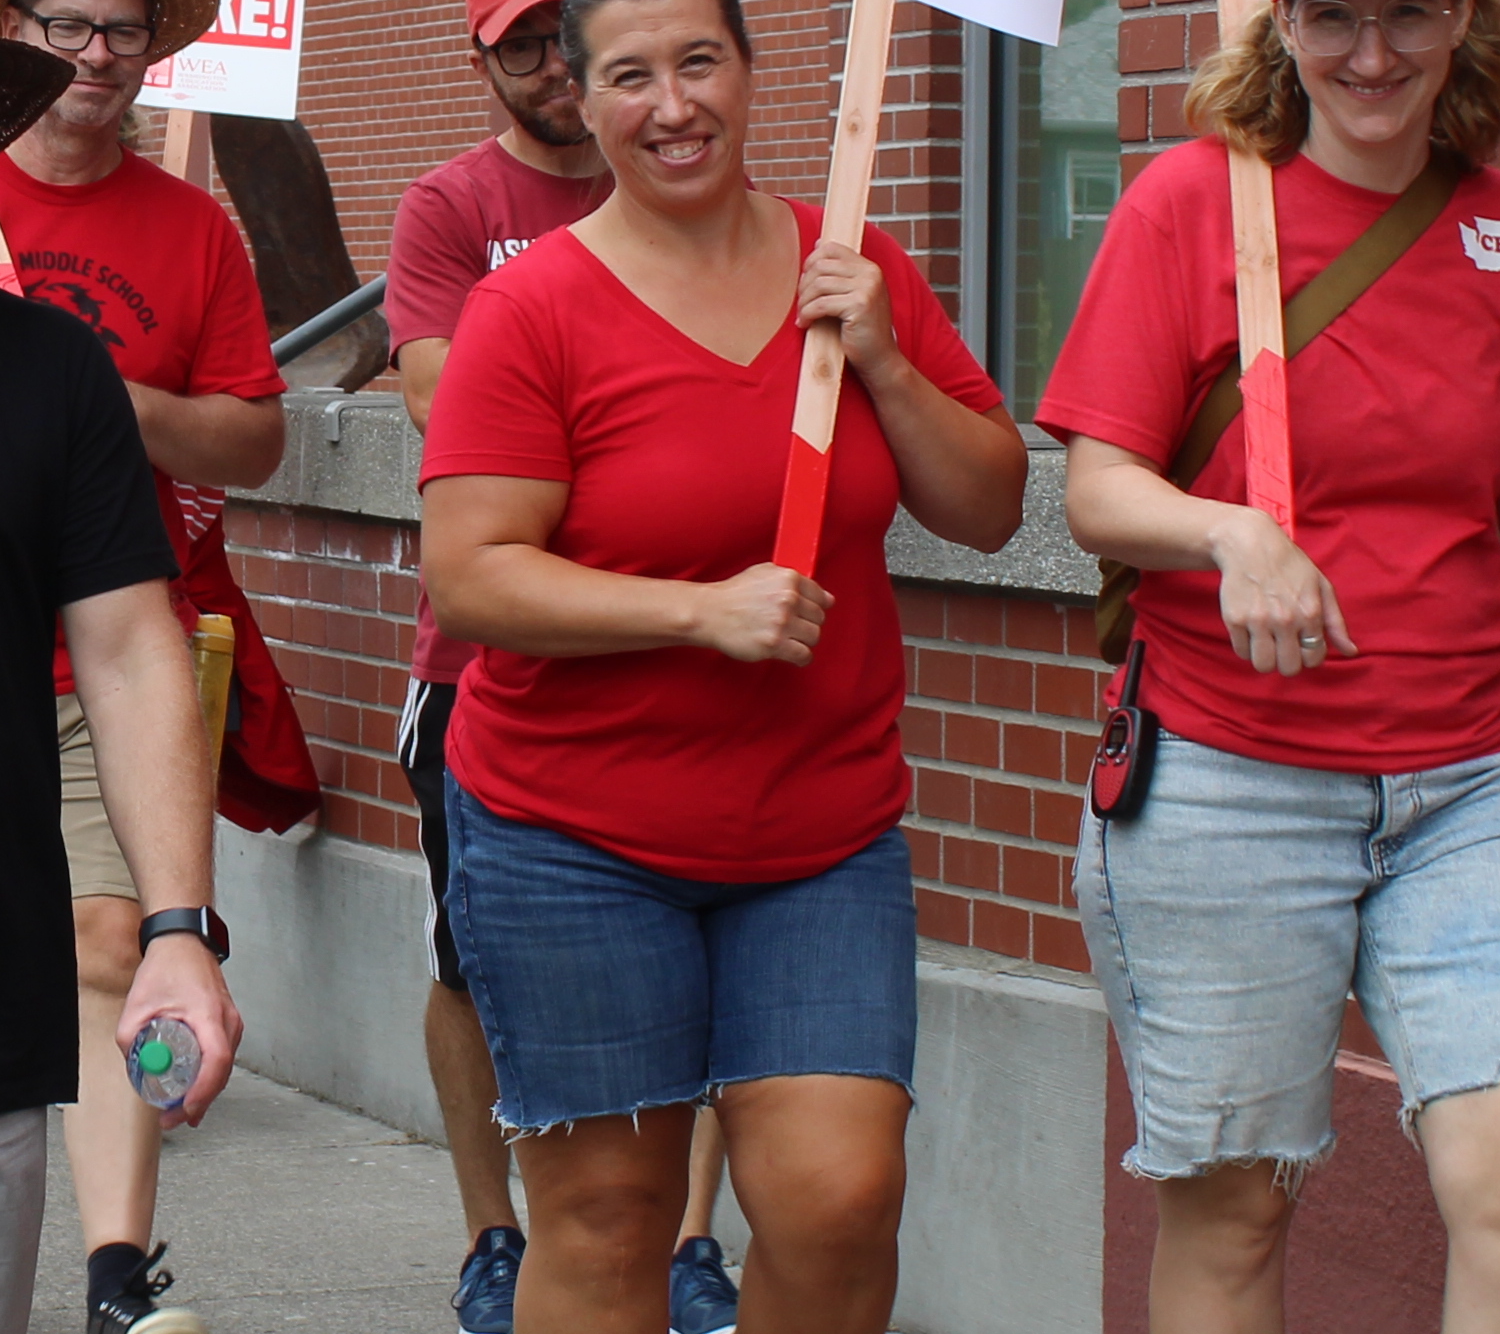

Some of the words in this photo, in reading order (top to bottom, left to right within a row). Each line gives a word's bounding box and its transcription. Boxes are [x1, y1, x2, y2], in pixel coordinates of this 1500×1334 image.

[178, 57, 227, 75] WEA
[18, 250, 94, 277] MIDDLE
[96, 265, 159, 335] SCHOOL
